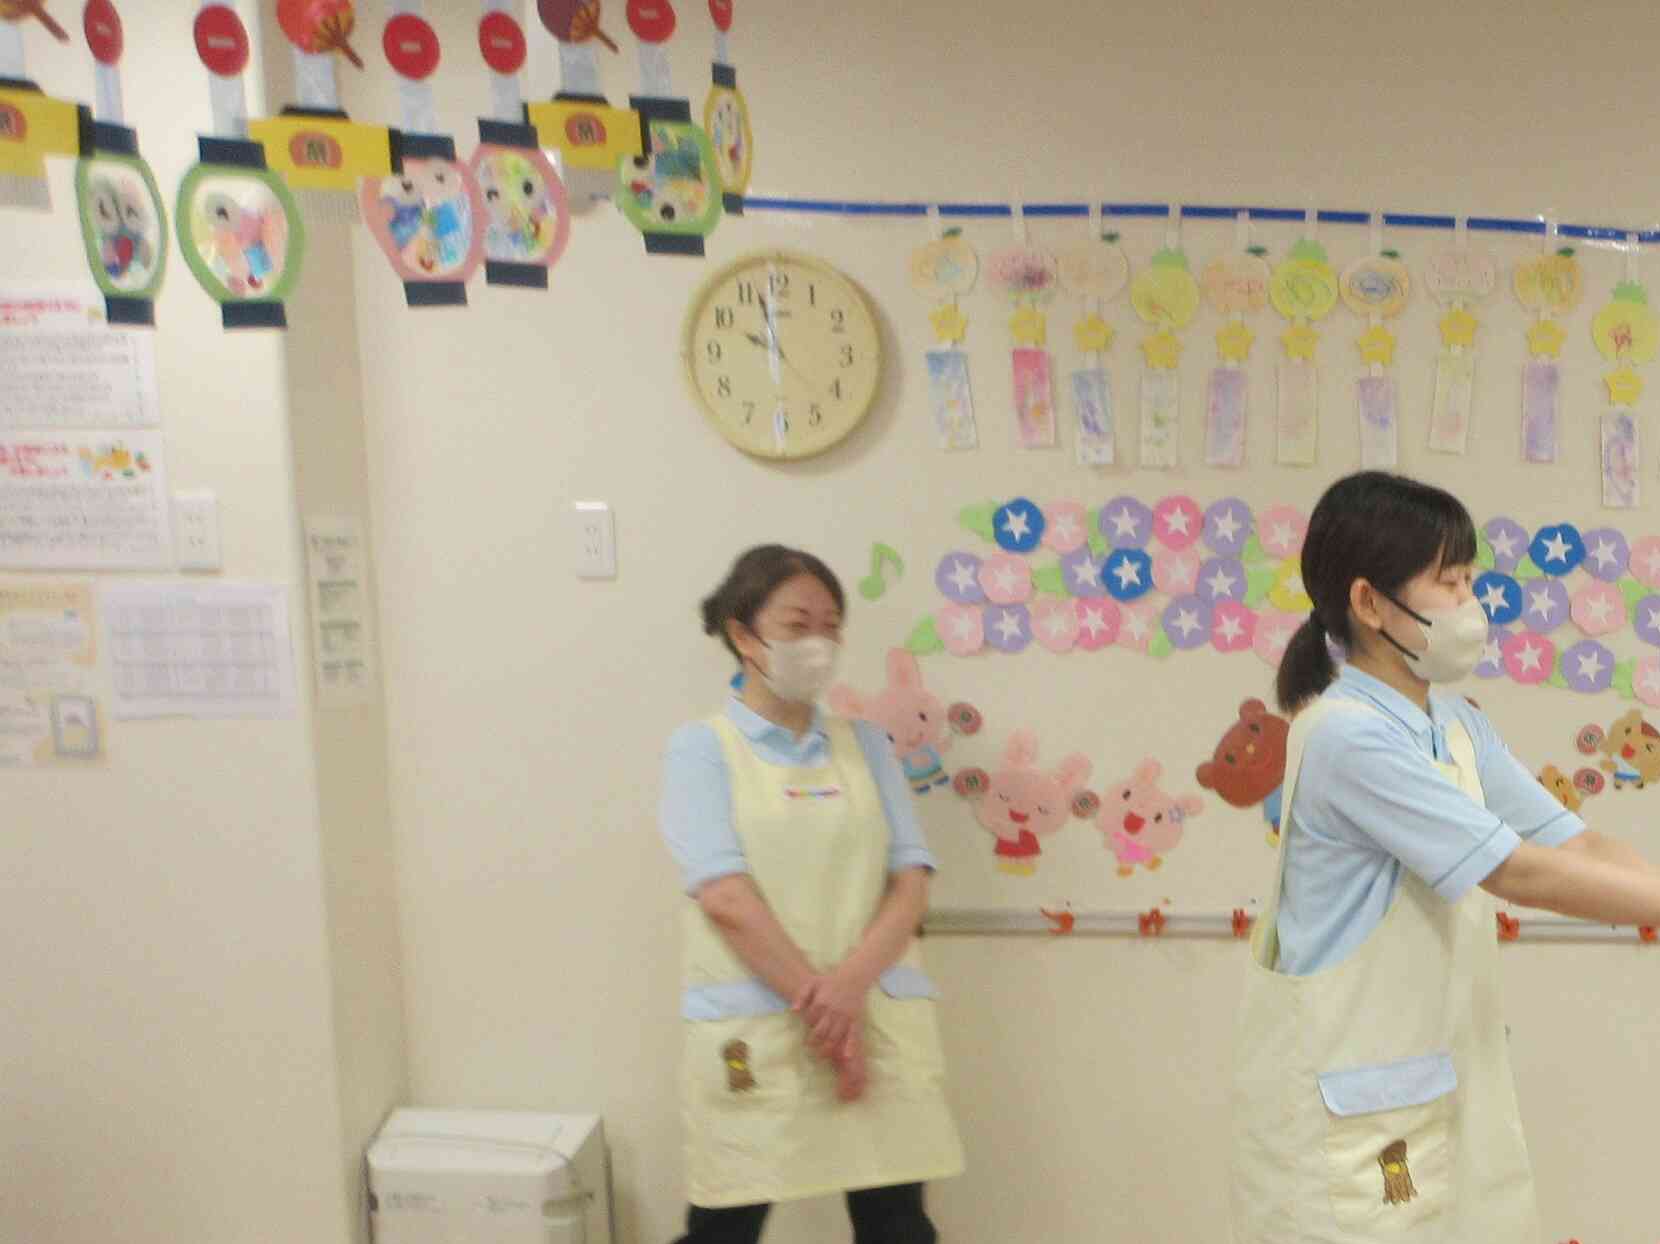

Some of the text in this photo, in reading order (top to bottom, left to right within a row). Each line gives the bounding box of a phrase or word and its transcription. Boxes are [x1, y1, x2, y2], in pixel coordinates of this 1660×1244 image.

[737, 283, 753, 305] 11
[767, 273, 789, 297] 12
[808, 284, 816, 306] 1
[714, 307, 734, 329] 10
[830, 310, 844, 333] 2
[706, 341, 722, 364] 9
[839, 345, 854, 368] 3
[717, 376, 731, 397] 8
[829, 379, 842, 400] 4
[741, 401, 756, 425] 7
[808, 405, 822, 426] 5
